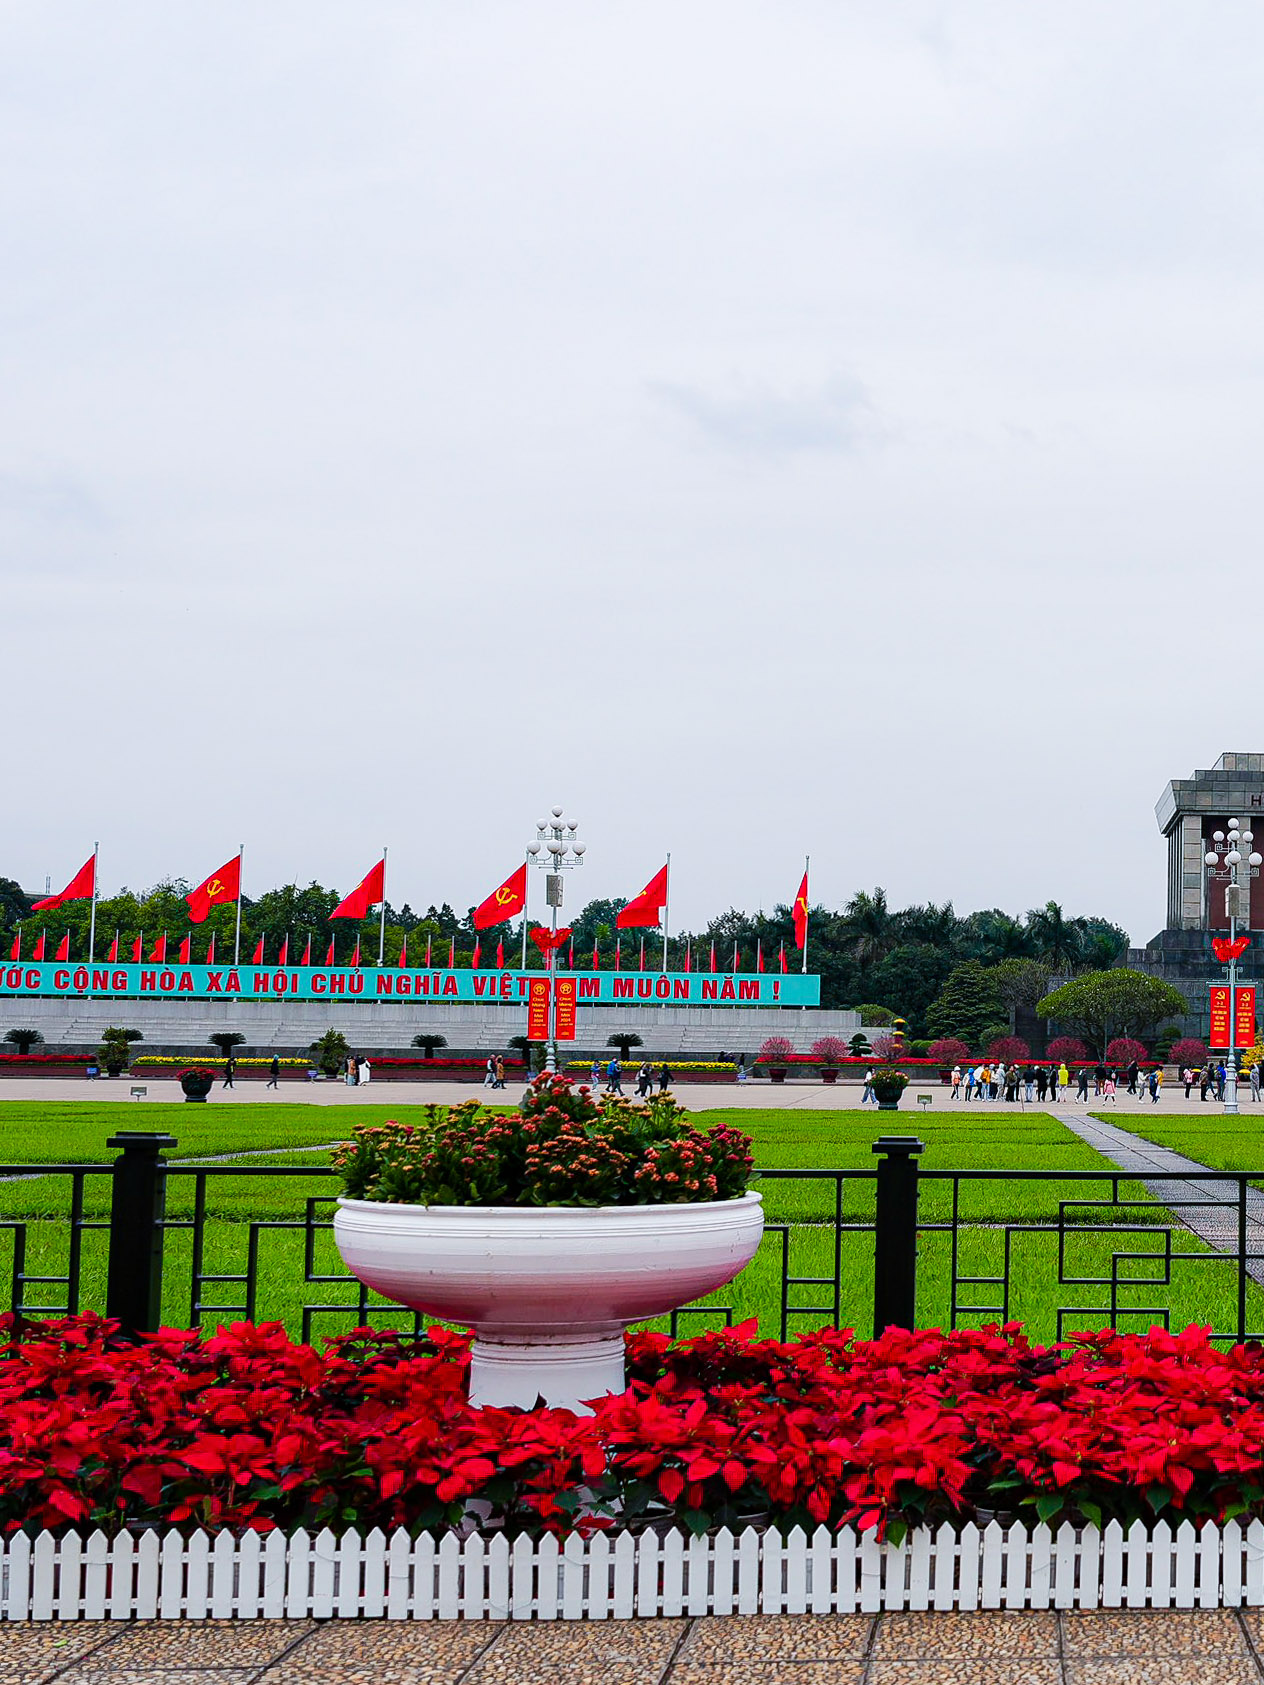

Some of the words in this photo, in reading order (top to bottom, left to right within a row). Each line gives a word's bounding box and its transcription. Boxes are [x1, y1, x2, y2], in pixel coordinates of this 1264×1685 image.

[54, 966, 128, 993] CỘNG
[140, 967, 194, 992] HÒA
[206, 968, 241, 992] XÃ
[254, 969, 298, 997] HỘI
[311, 968, 364, 994] CHỦ
[376, 972, 458, 996] NGHĨA
[473, 973, 529, 999] VIỆT
[613, 975, 690, 999] MUÔN
[702, 976, 760, 1000] NĂM
[773, 981, 780, 1000] !
